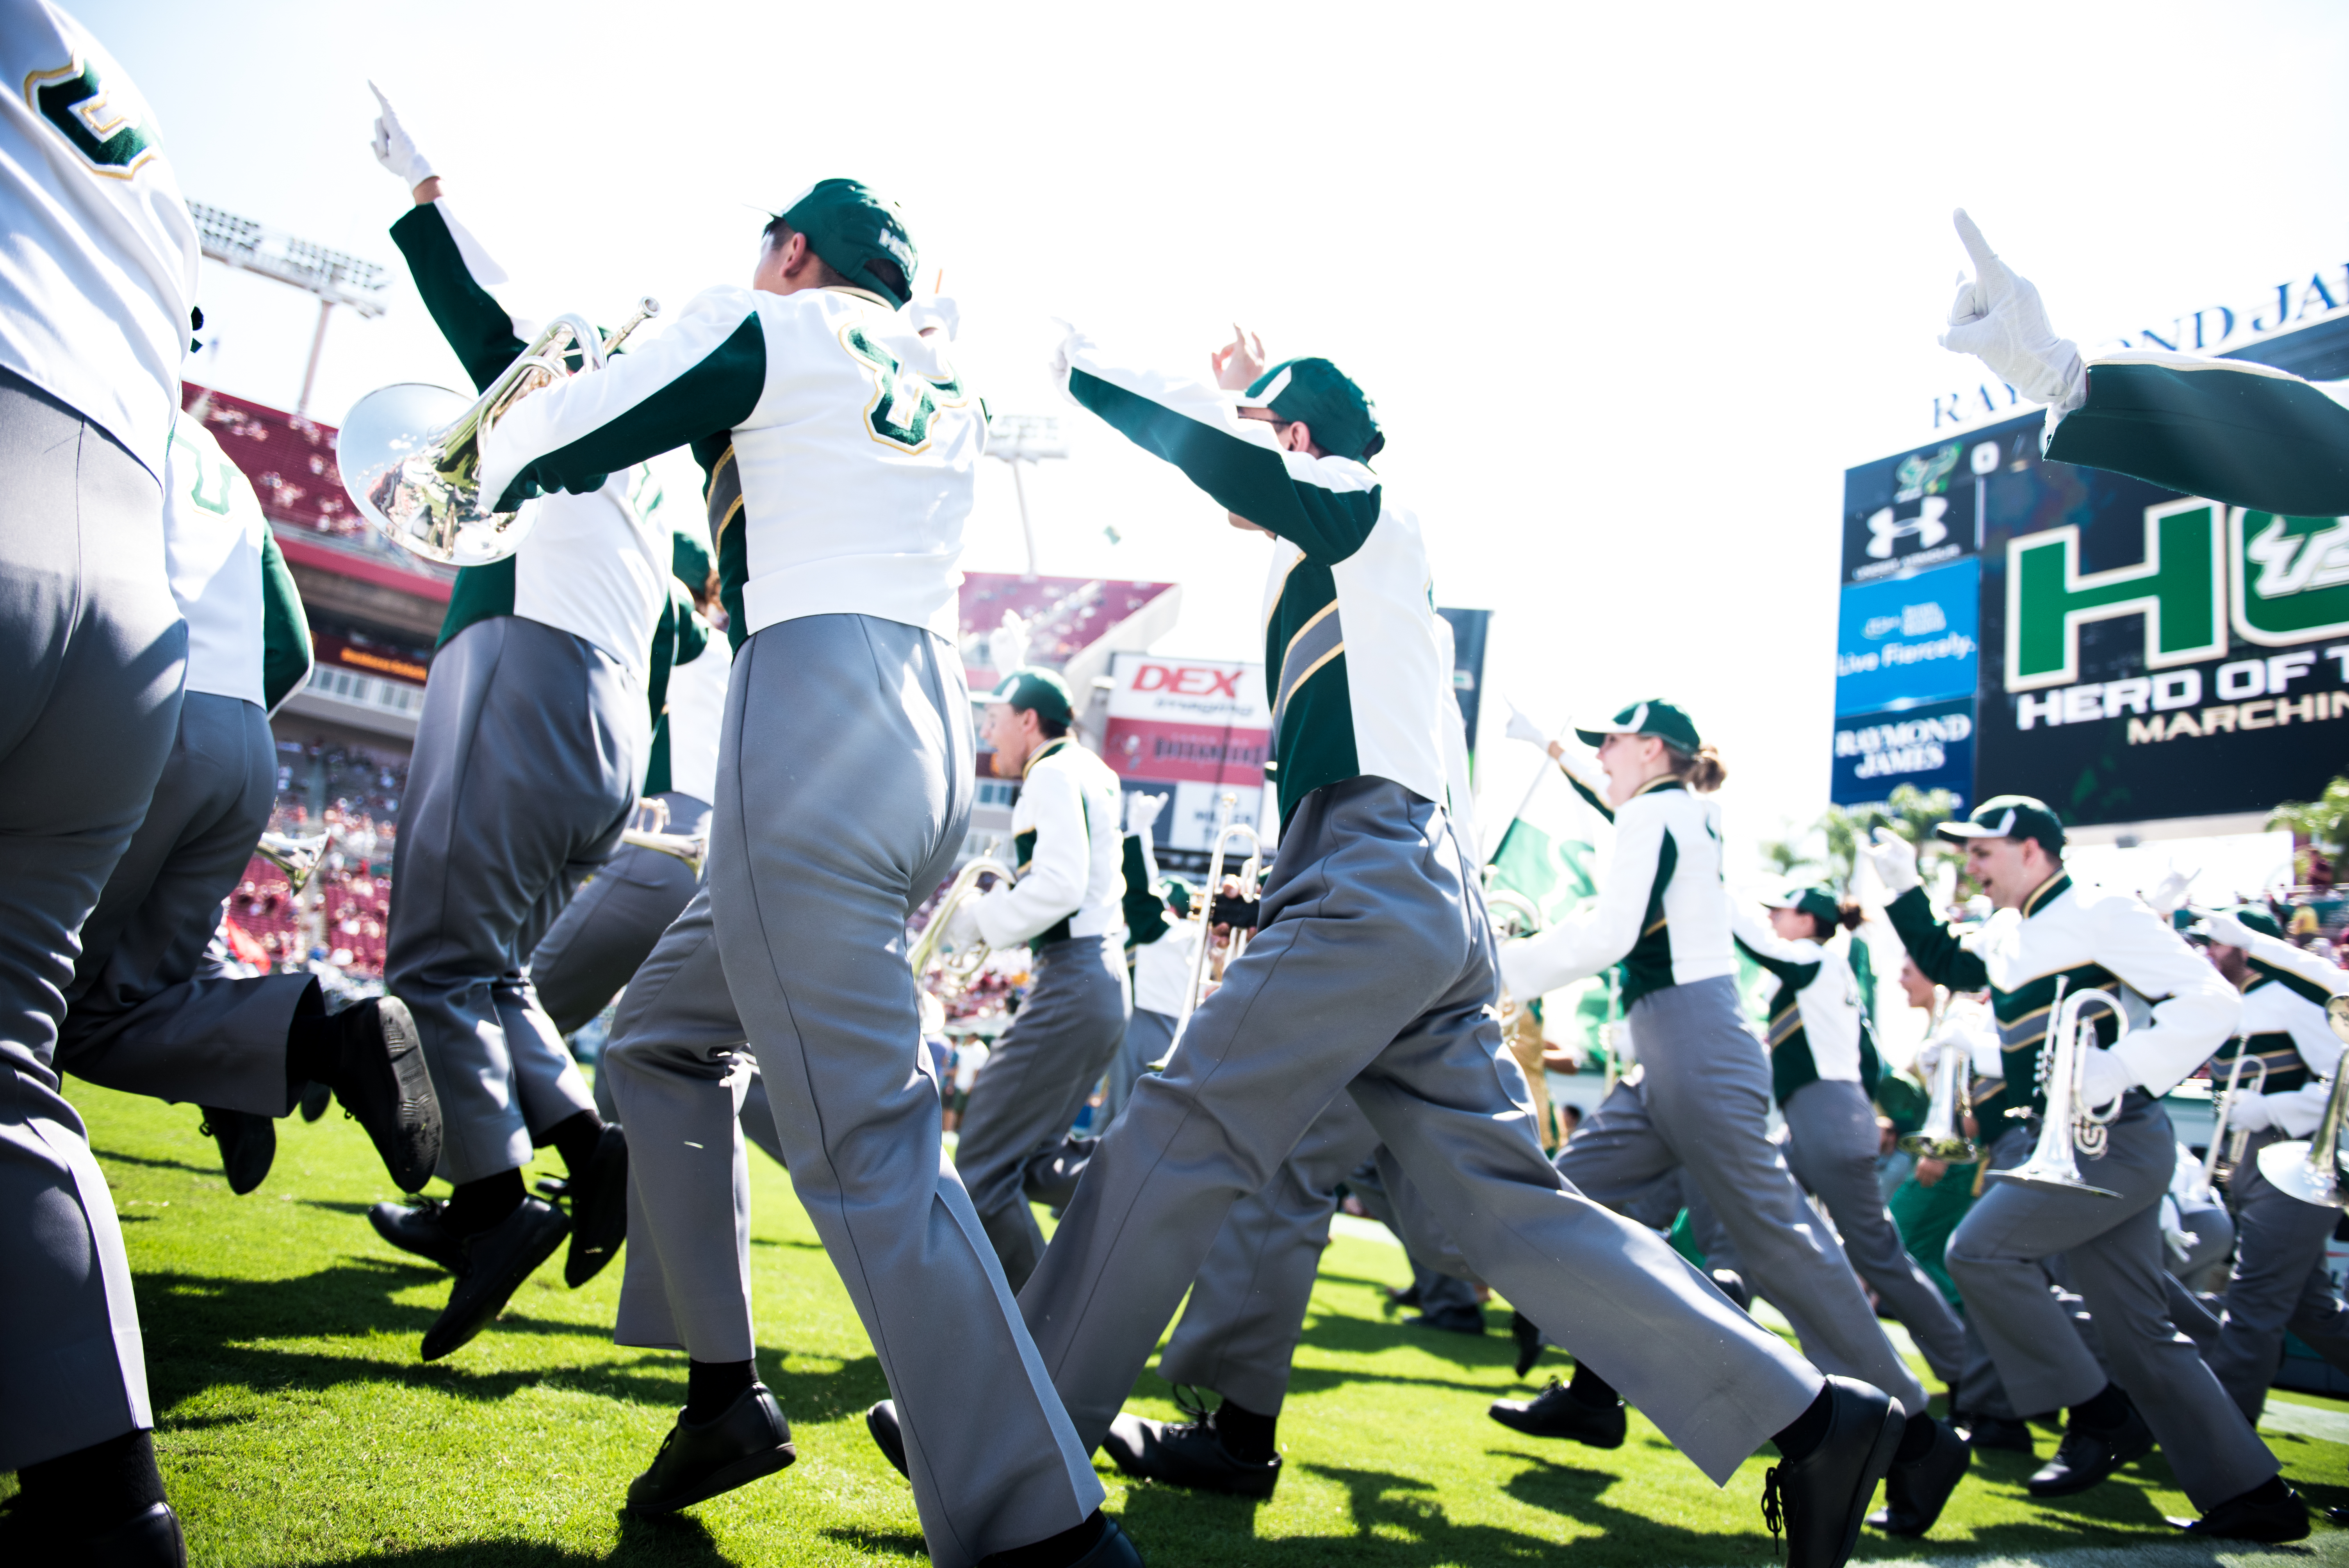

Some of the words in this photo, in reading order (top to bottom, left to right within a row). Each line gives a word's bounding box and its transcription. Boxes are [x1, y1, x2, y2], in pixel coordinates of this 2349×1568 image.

[2252, 262, 2349, 332] JA
[1132, 665, 1246, 699] DEX
[2016, 668, 2202, 731] HERD
[2215, 650, 2317, 701] OF
[1835, 713, 1971, 758] RAYMOND
[1854, 742, 1946, 780] JAMES
